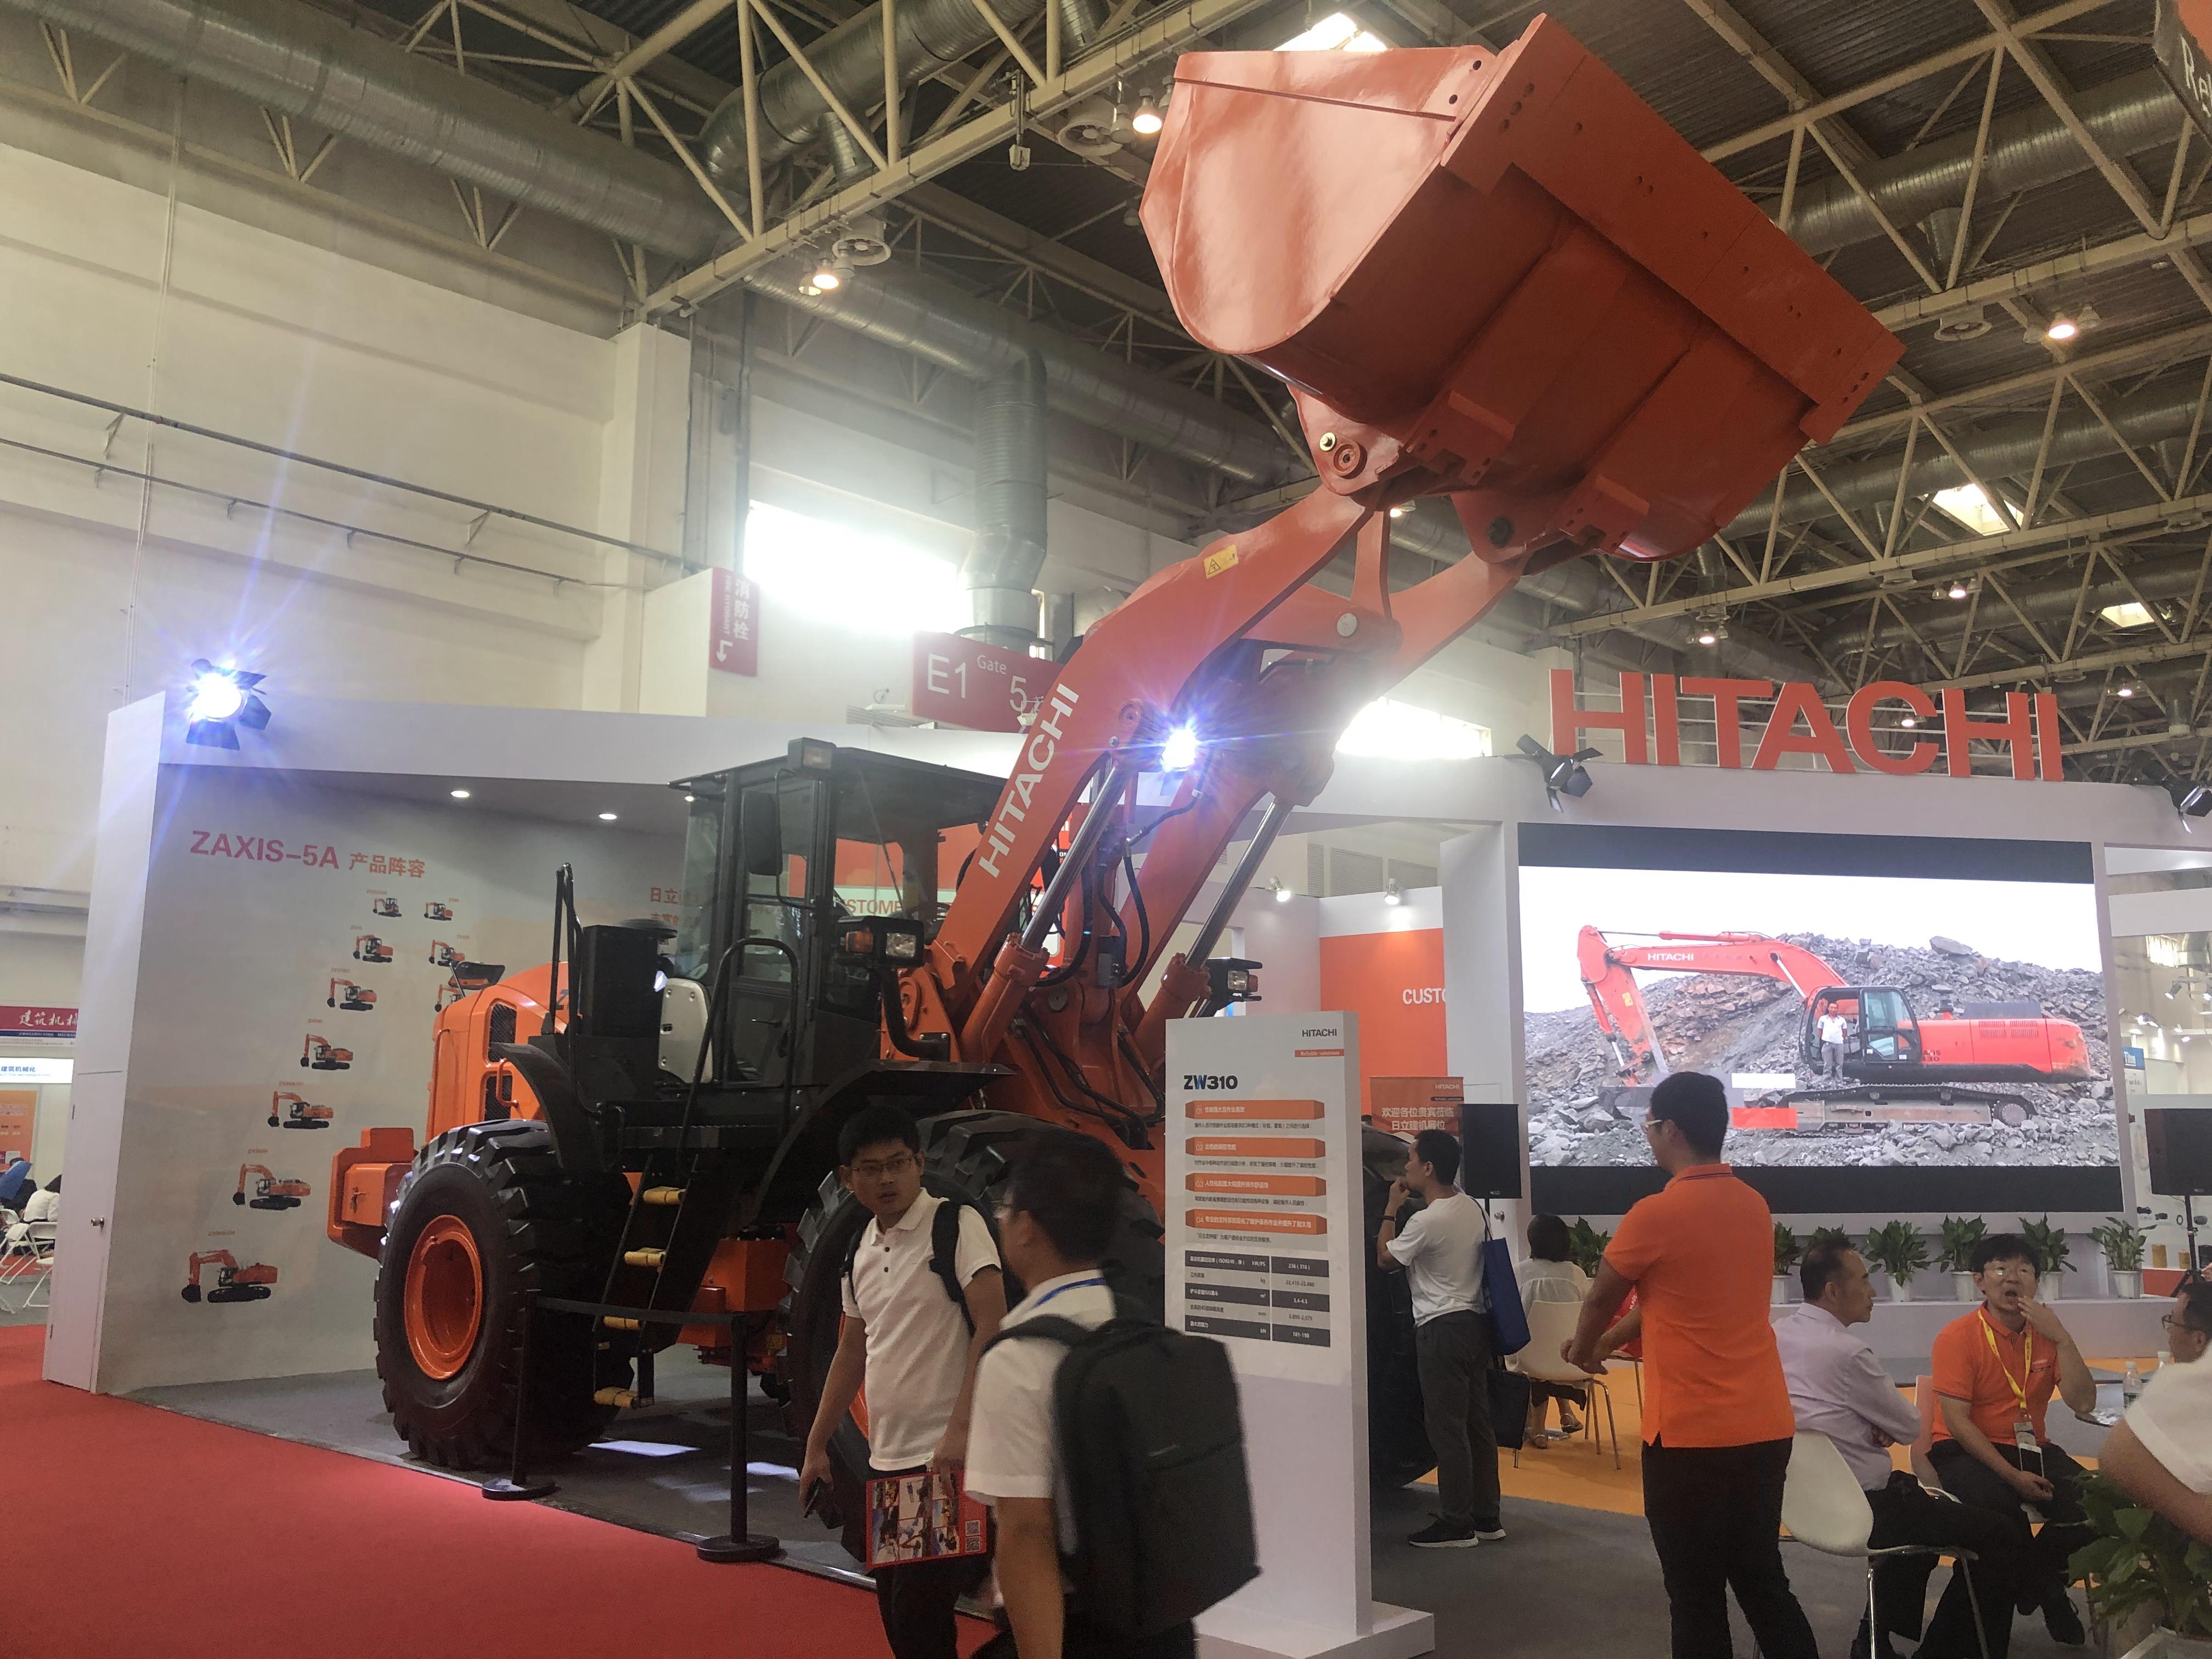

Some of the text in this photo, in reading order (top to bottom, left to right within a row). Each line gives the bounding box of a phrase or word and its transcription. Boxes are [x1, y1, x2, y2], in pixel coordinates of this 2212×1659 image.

[733, 578, 750, 641] 消防栓
[927, 653, 966, 698] E1
[977, 654, 1007, 675] Gate
[1549, 667, 2065, 782] HITACHI
[978, 683, 1079, 878] HITACHI
[190, 831, 426, 878] ZAXIS-5A 产品阵容
[1302, 1029, 1337, 1037] HITACHI
[1184, 1075, 1238, 1090] ZW310
[1381, 1107, 1454, 1118] 欢迎各位贵宾莅临
[1392, 1120, 1446, 1131] 日立建机展位
